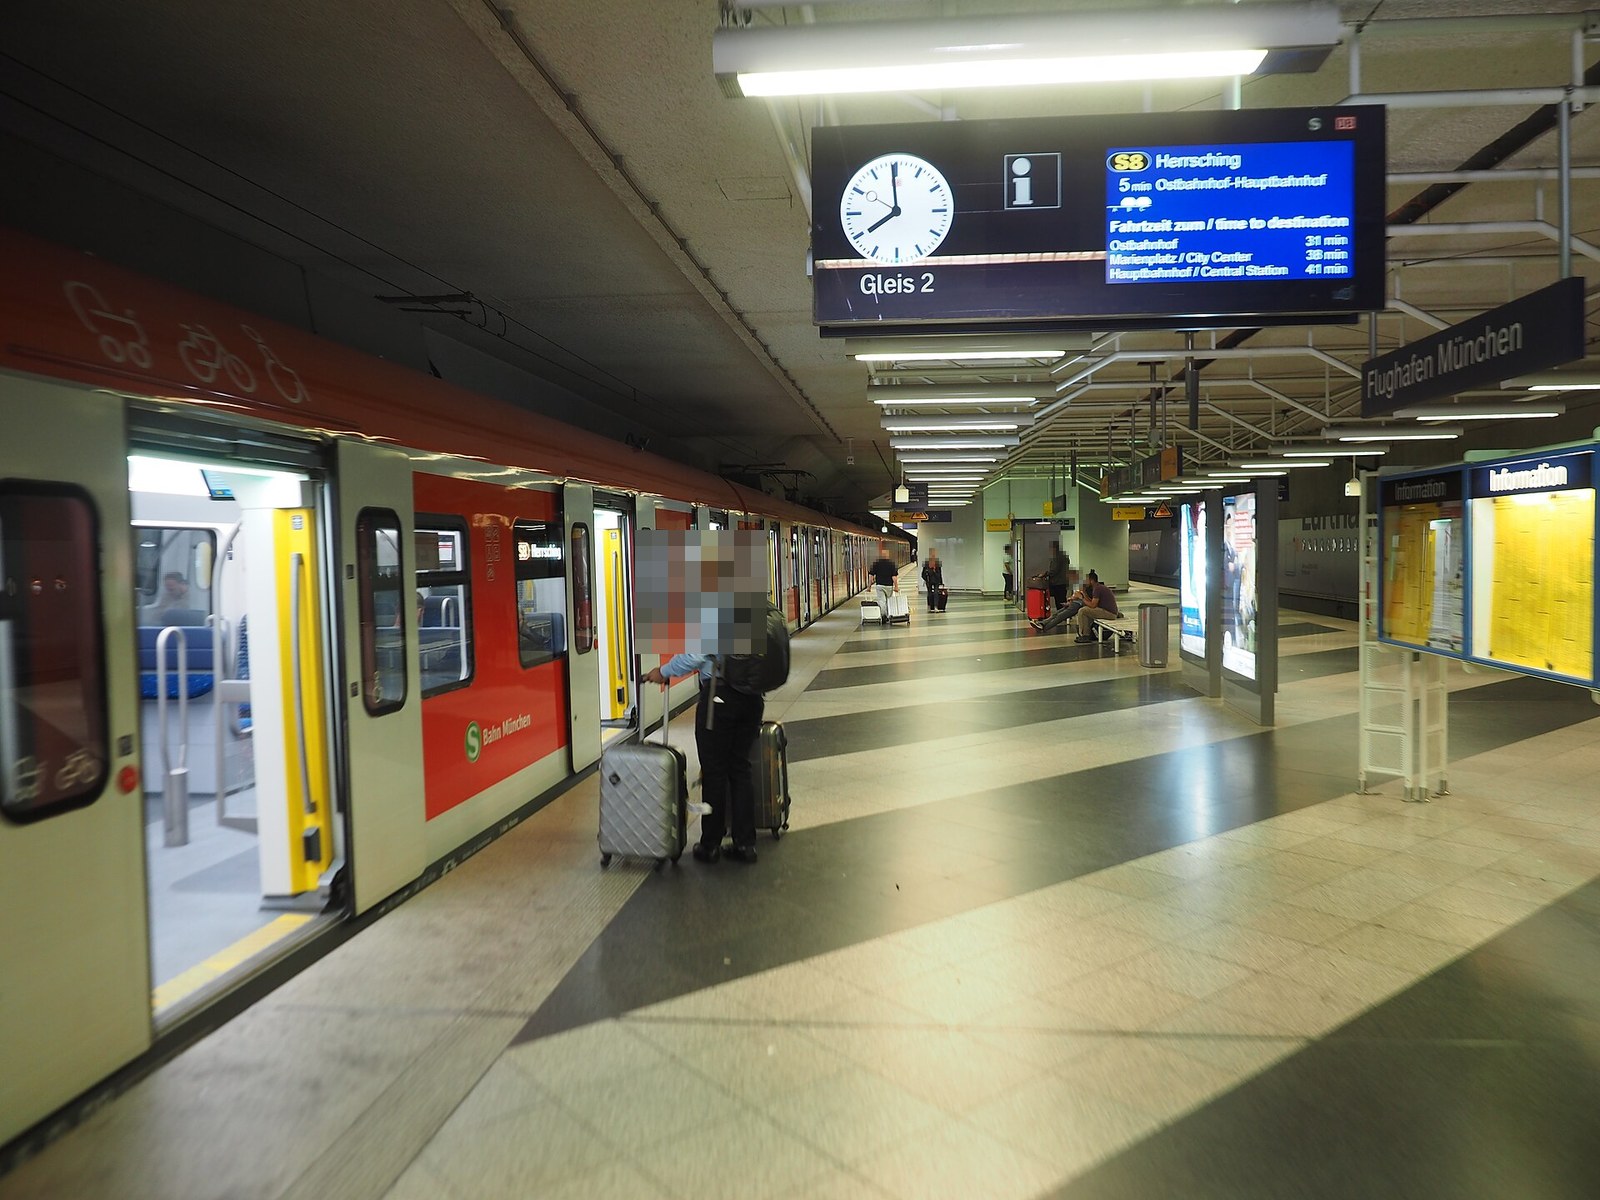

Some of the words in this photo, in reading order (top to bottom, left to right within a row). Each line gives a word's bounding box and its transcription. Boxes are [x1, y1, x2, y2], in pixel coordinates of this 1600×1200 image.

[1114, 153, 1145, 170] S8
[1155, 151, 1242, 170] Herrsching
[1119, 178, 1131, 192] 5
[1131, 180, 1152, 192] min
[1109, 219, 1174, 233] Fahrtzeit
[1174, 220, 1206, 232] zum
[1215, 217, 1248, 230] time
[1249, 217, 1267, 230] to
[1267, 214, 1350, 230] destination
[1109, 238, 1179, 251] Ostbahnhof
[1305, 235, 1322, 247] 31
[1324, 234, 1348, 246] min
[1186, 252, 1211, 265] City
[1211, 251, 1254, 263] Center
[1324, 248, 1348, 260] min
[1201, 264, 1245, 278] Central
[1245, 263, 1289, 276] Station
[1324, 263, 1348, 275] min
[860, 273, 915, 295] Gleis
[920, 272, 935, 293] 2
[1366, 353, 1434, 399] Flughafen
[1437, 321, 1523, 375] München
[1489, 462, 1568, 492] Information
[1394, 479, 1448, 501] Information
[467, 725, 479, 759] S
[482, 724, 502, 746] Bahn
[502, 713, 531, 738] München
